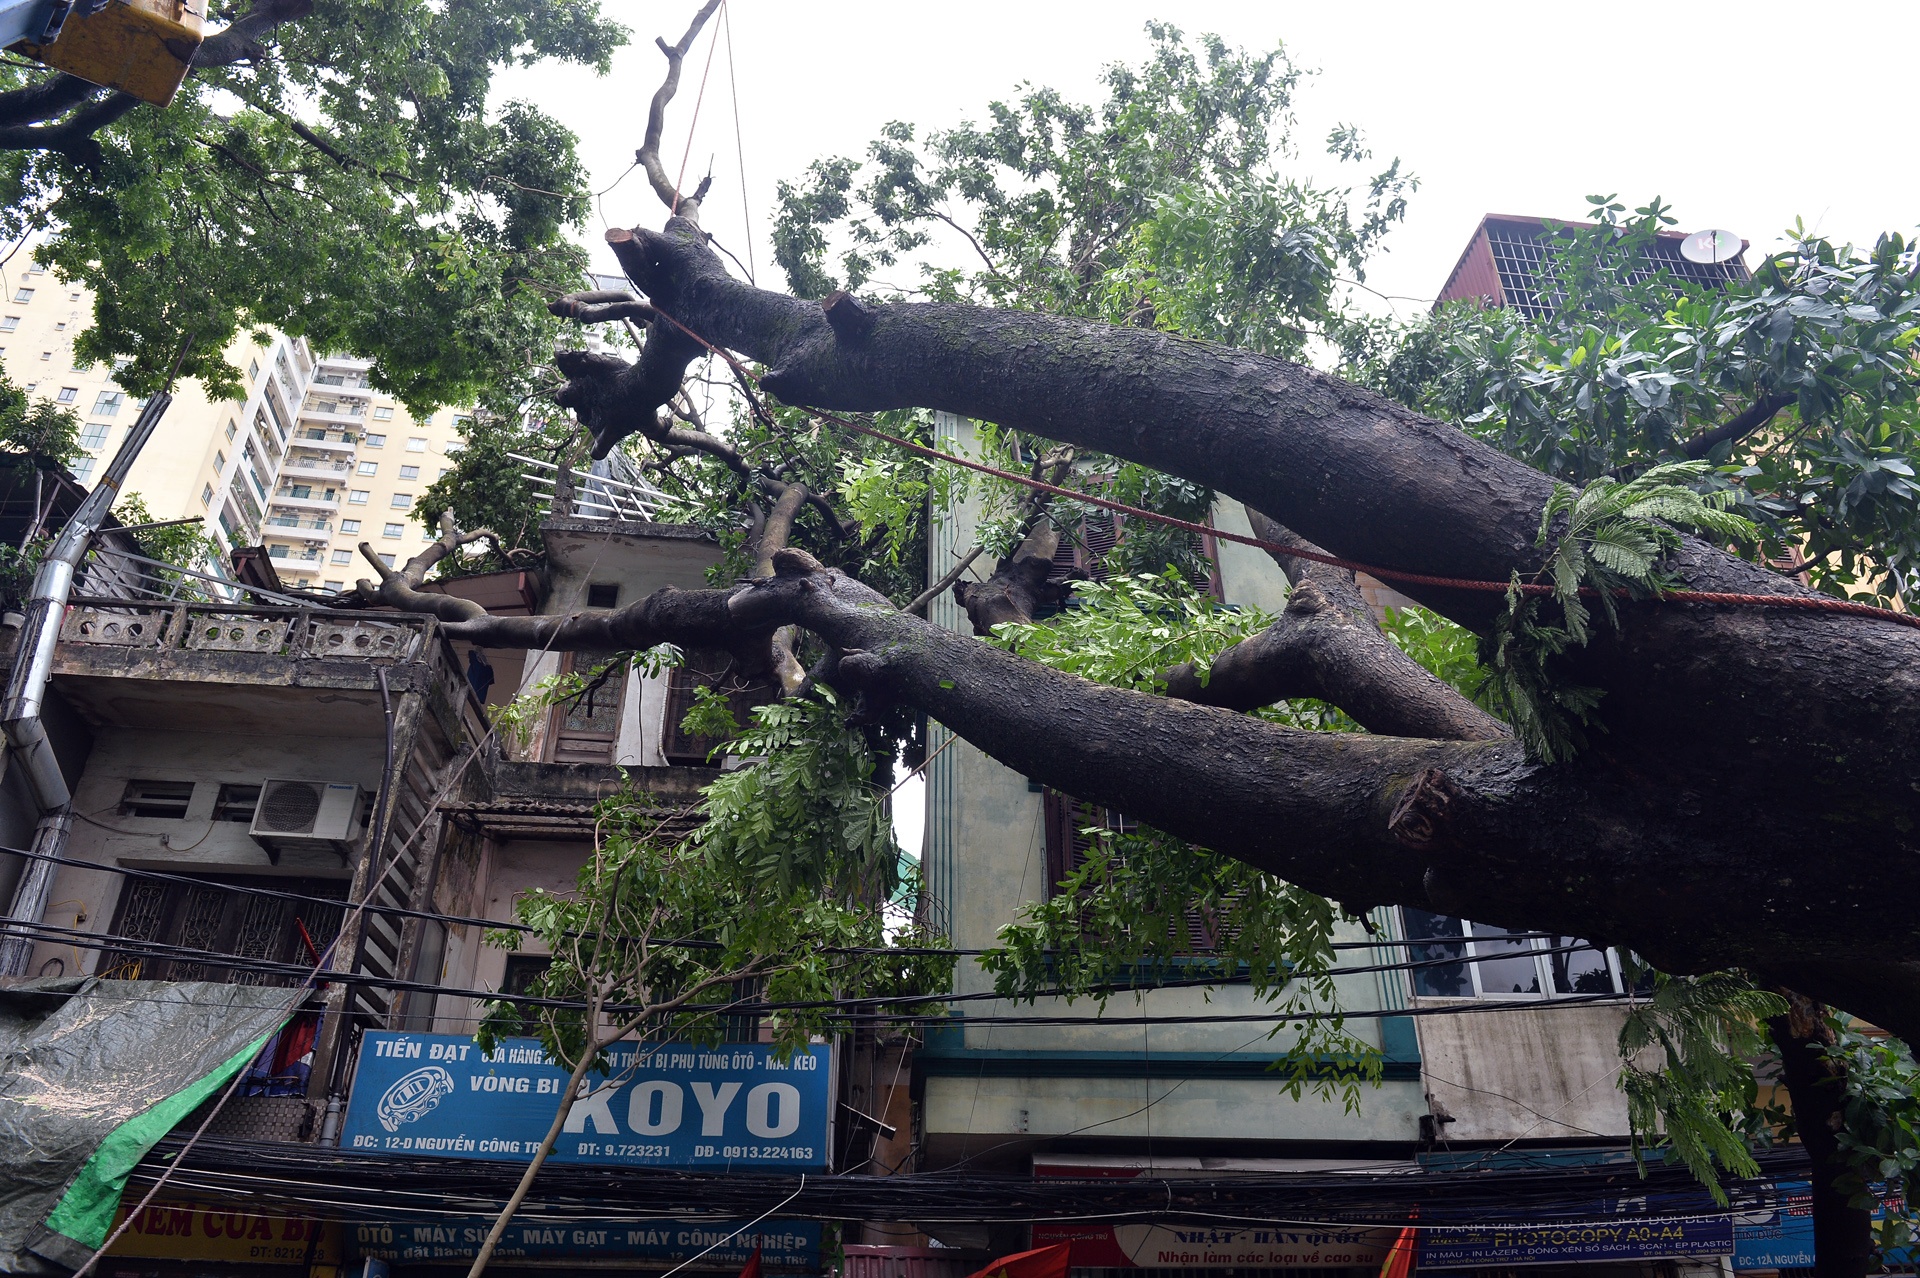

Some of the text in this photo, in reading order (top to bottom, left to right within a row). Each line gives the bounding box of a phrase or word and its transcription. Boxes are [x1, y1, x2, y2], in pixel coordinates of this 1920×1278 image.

[375, 1036, 471, 1064] TIẾN ĐẠT
[508, 1045, 543, 1065] HÀNG
[621, 1048, 653, 1068] THẾT
[655, 1053, 668, 1071] BỊ
[670, 1053, 696, 1072] PHỤ
[698, 1051, 729, 1070] TÙNG
[731, 1051, 754, 1070] ÔTÔ
[536, 1078, 560, 1094] BI
[562, 1079, 801, 1139] KOYO
[353, 1135, 379, 1148] ĐC:
[414, 1133, 475, 1152] NGUYỄN
[478, 1137, 520, 1153] CÔNG
[524, 1141, 544, 1154] TR
[578, 1143, 600, 1156] ĐT:
[604, 1144, 670, 1157] 9.723231
[722, 1146, 813, 1160] 0913.224163
[357, 1222, 807, 1252] ÔTÔ MÁY SÚ MÁY GẠT MÁY CÔNG NGHIỆP
[1174, 1228, 1236, 1248] NHẬT
[1254, 1228, 1298, 1244] HÀN
[1494, 1227, 1623, 1247] PHOTOCOPY
[274, 1247, 325, 1260] 821228
[1158, 1251, 1199, 1266] Nhận
[1203, 1251, 1232, 1263] làm
[1236, 1251, 1264, 1263] các
[1269, 1251, 1298, 1265] loại
[1324, 1254, 1352, 1263] cao
[1356, 1254, 1374, 1263] su
[1472, 1250, 1483, 1258] IN
[1485, 1248, 1519, 1257] LAZER
[1690, 1239, 1732, 1248] PLASTIC
[1739, 1256, 1755, 1266] ĐC:
[1774, 1250, 1811, 1265] NGUYỄN
